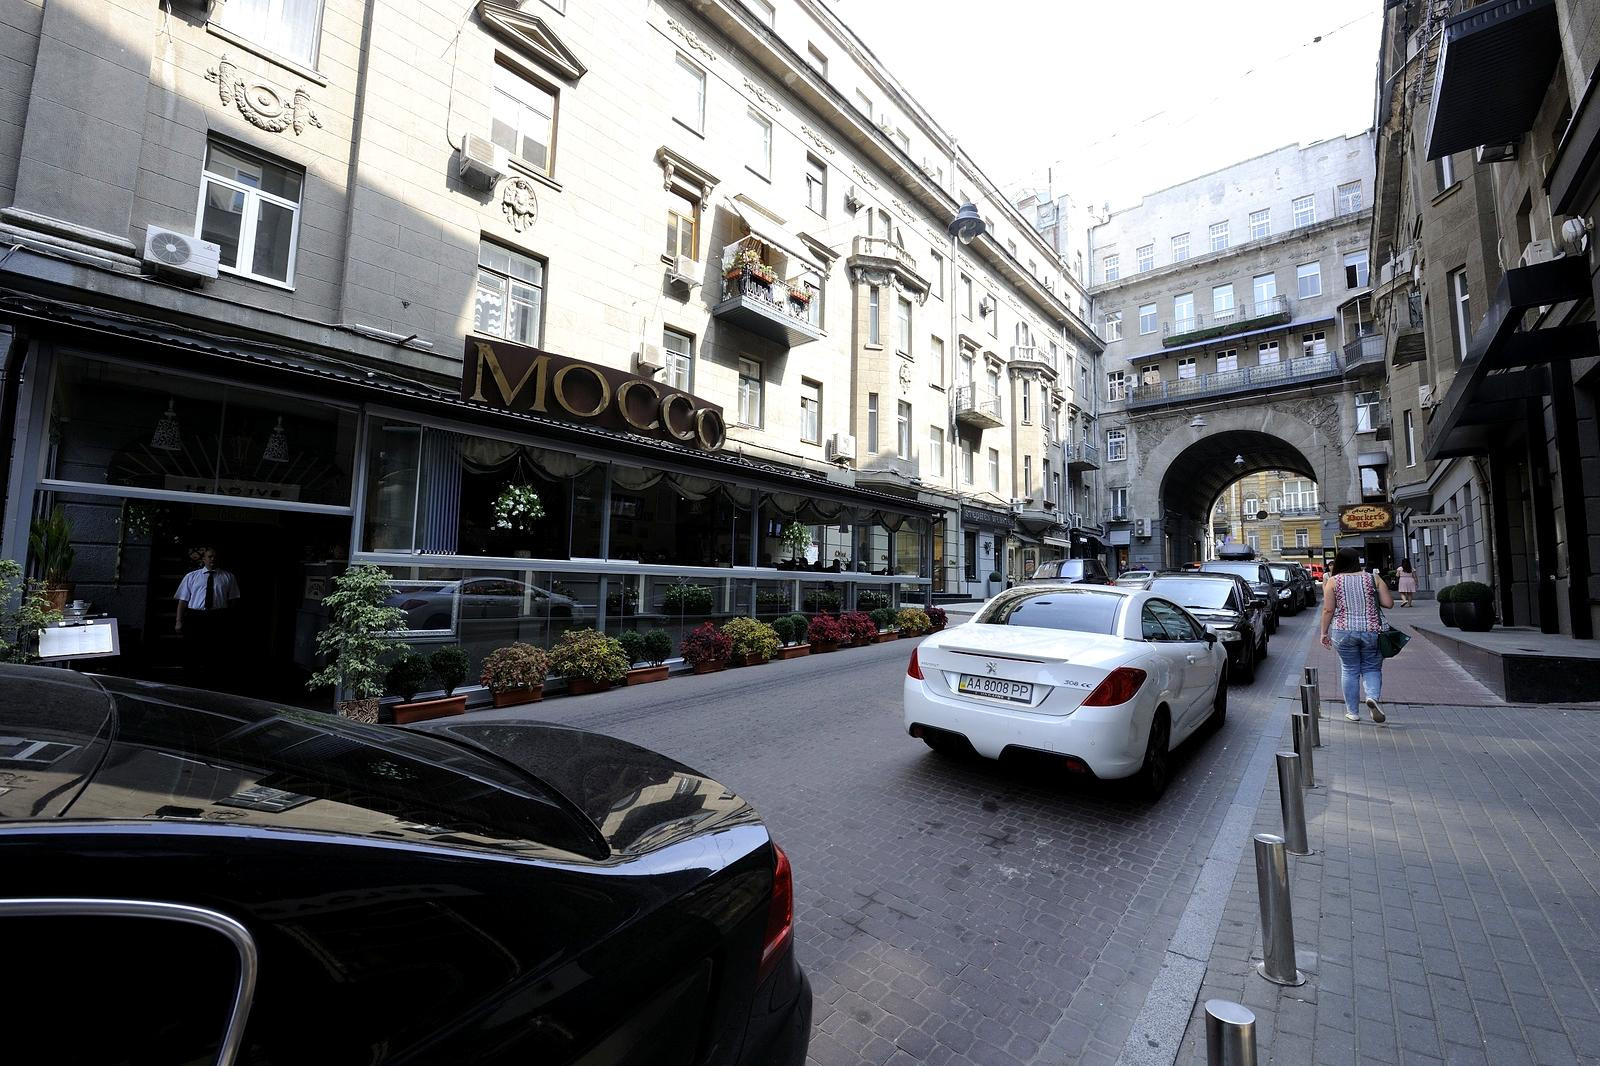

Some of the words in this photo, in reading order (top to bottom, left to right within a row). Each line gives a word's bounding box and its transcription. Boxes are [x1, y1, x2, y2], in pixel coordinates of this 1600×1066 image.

[470, 341, 726, 451] MOCCO
[1412, 516, 1460, 524] BURBERRY
[967, 677, 981, 690] AA
[984, 679, 1009, 694] 8008
[1011, 683, 1029, 697] PP
